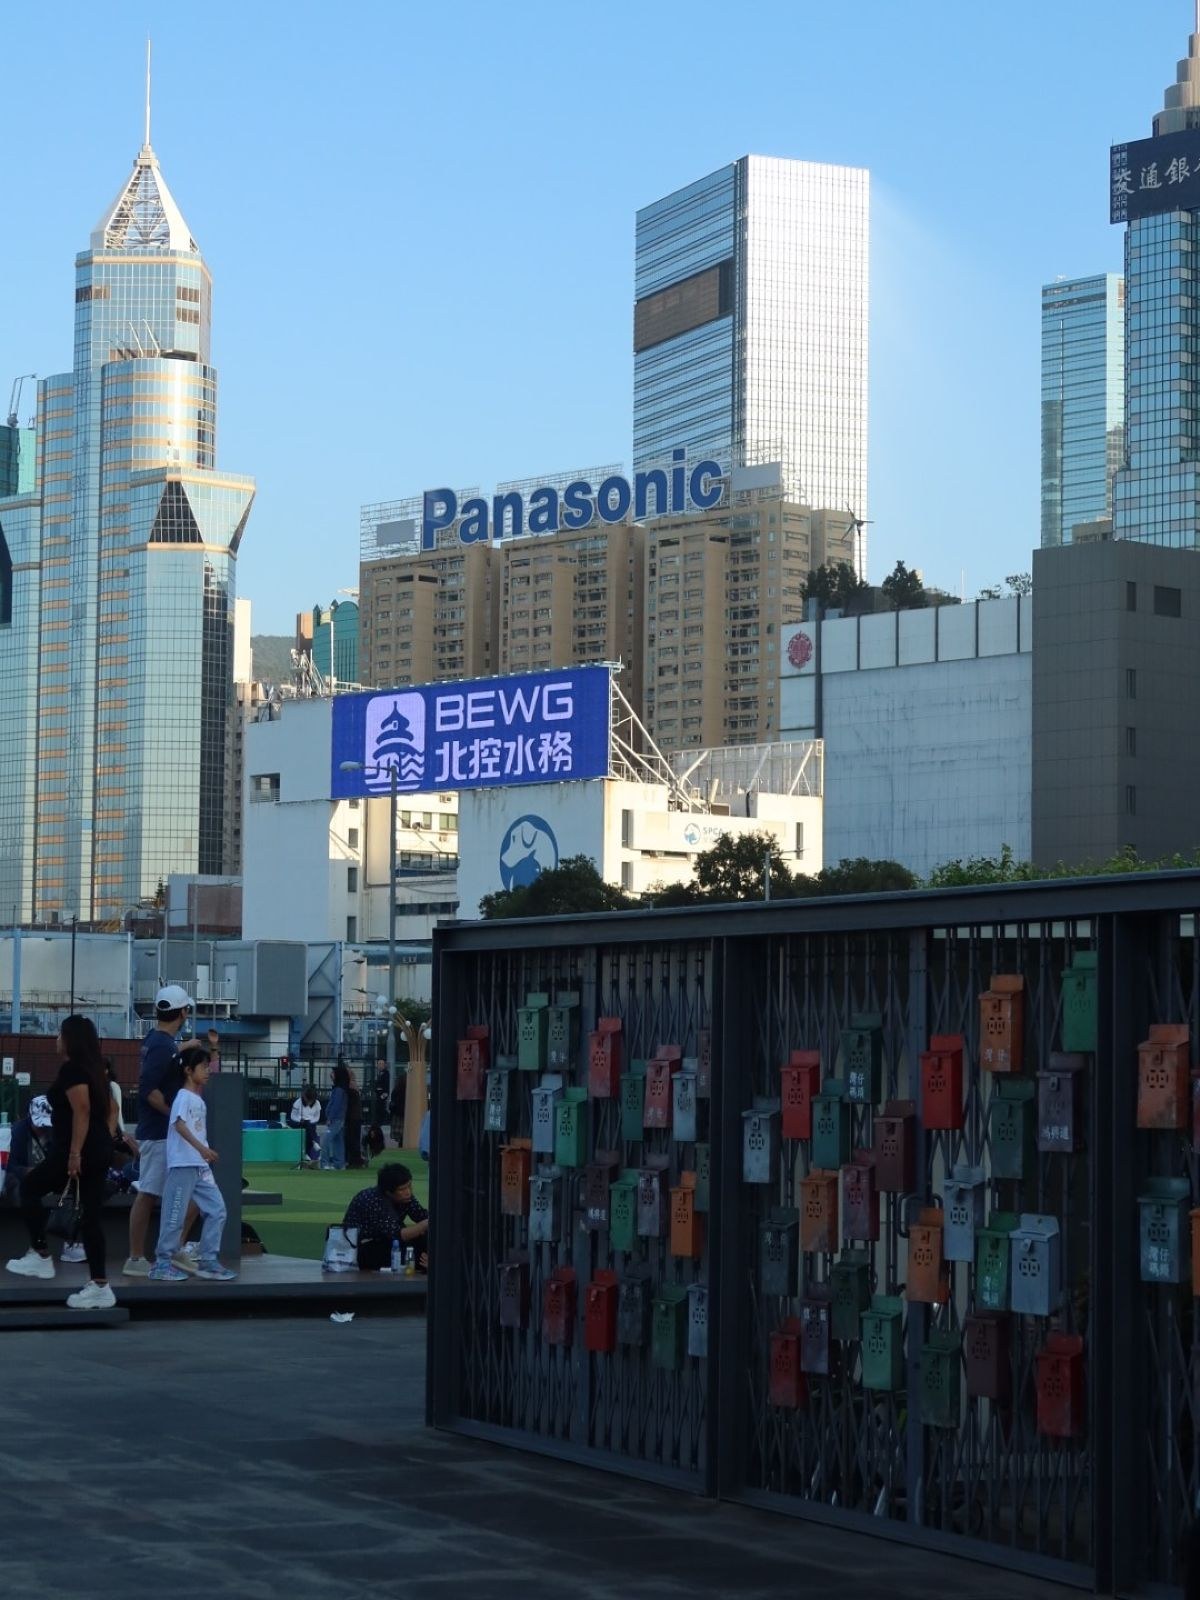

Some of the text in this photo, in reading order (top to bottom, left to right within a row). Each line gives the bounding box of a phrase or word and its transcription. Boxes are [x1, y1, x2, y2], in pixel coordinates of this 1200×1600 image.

[1113, 157, 1200, 194] 交通銀
[421, 447, 723, 551] Panasonic
[435, 682, 573, 732] BEWG
[435, 731, 572, 782] 北控水務
